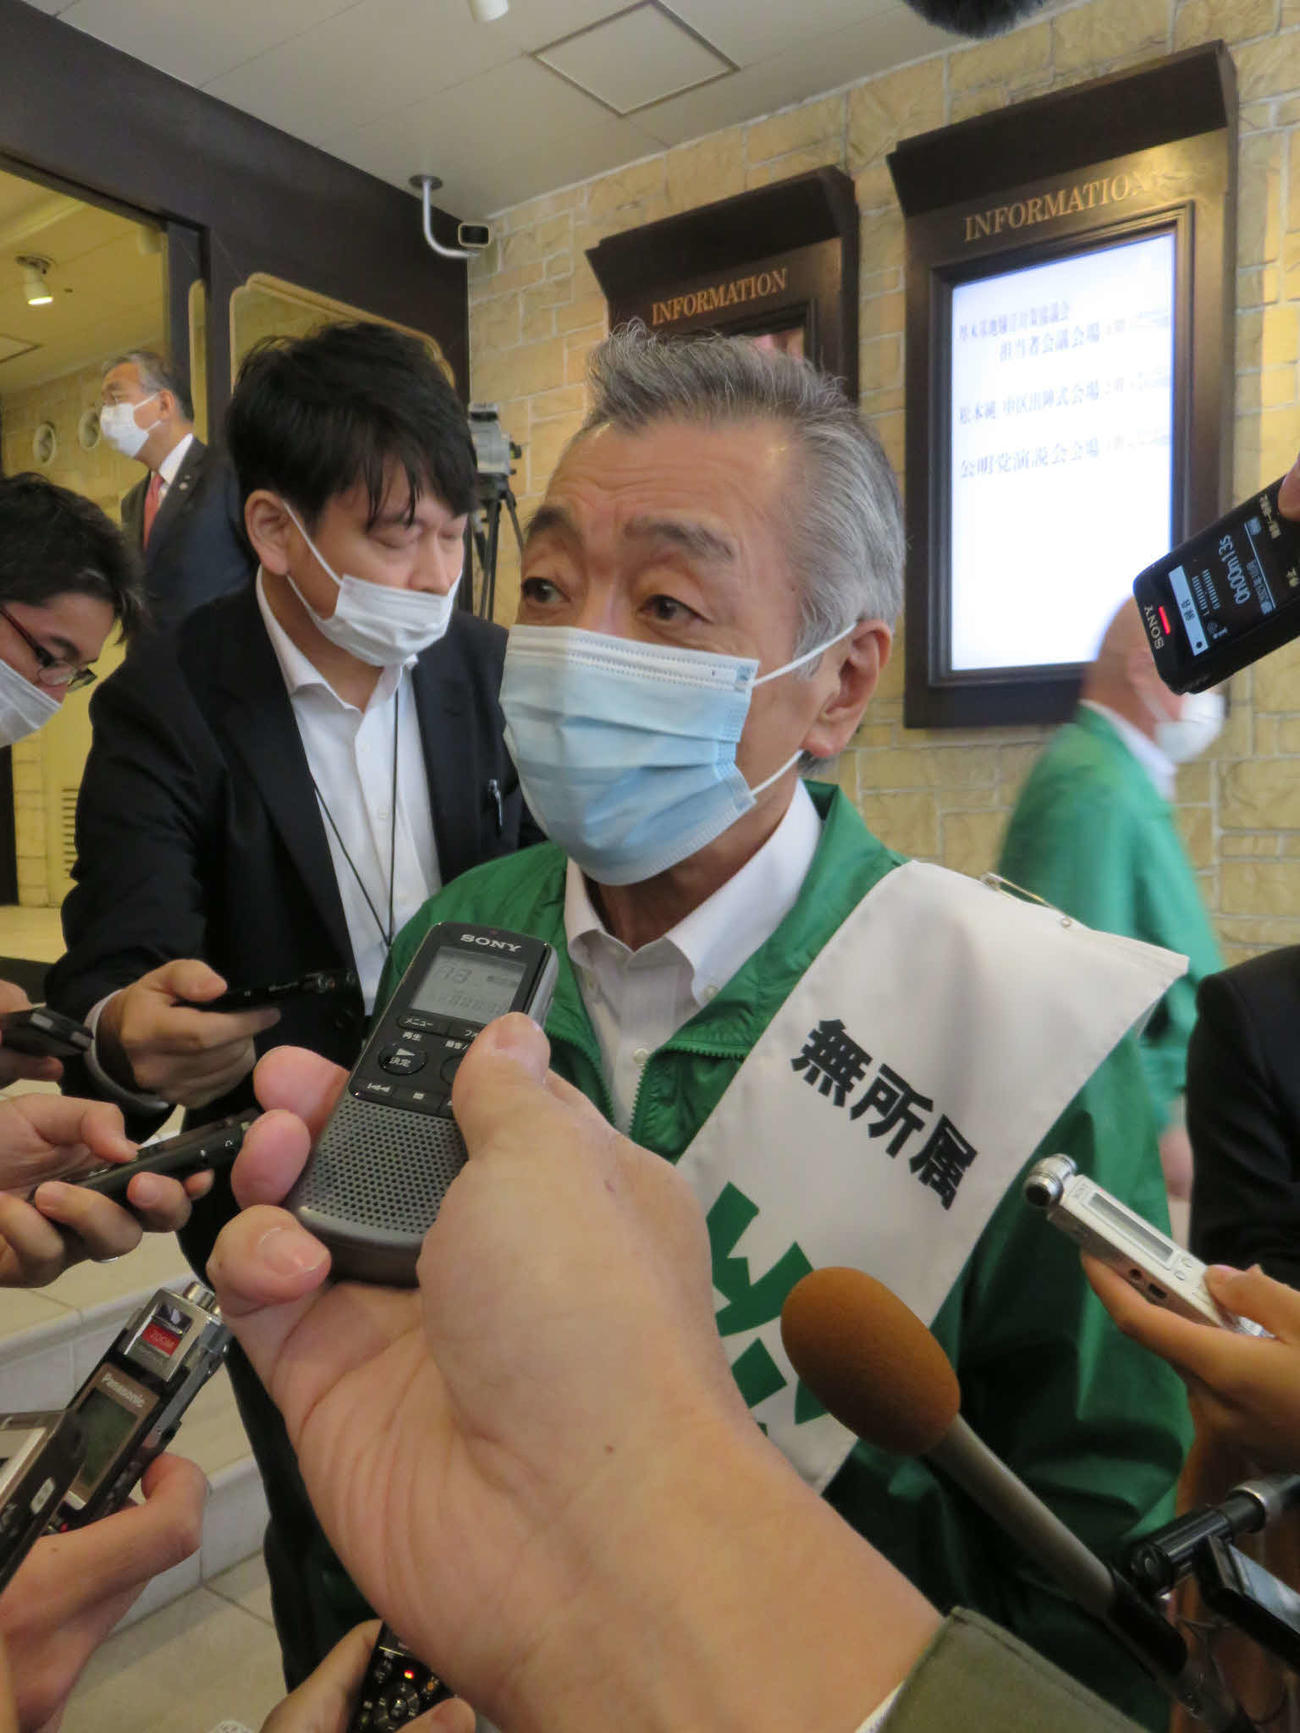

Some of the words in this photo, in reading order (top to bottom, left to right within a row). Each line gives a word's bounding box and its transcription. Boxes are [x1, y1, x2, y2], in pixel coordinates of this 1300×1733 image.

[652, 268, 788, 325] INFORMATION
[1144, 604, 1165, 650] SONY
[460, 933, 523, 953] SONY
[790, 1018, 979, 1212] 無所属
